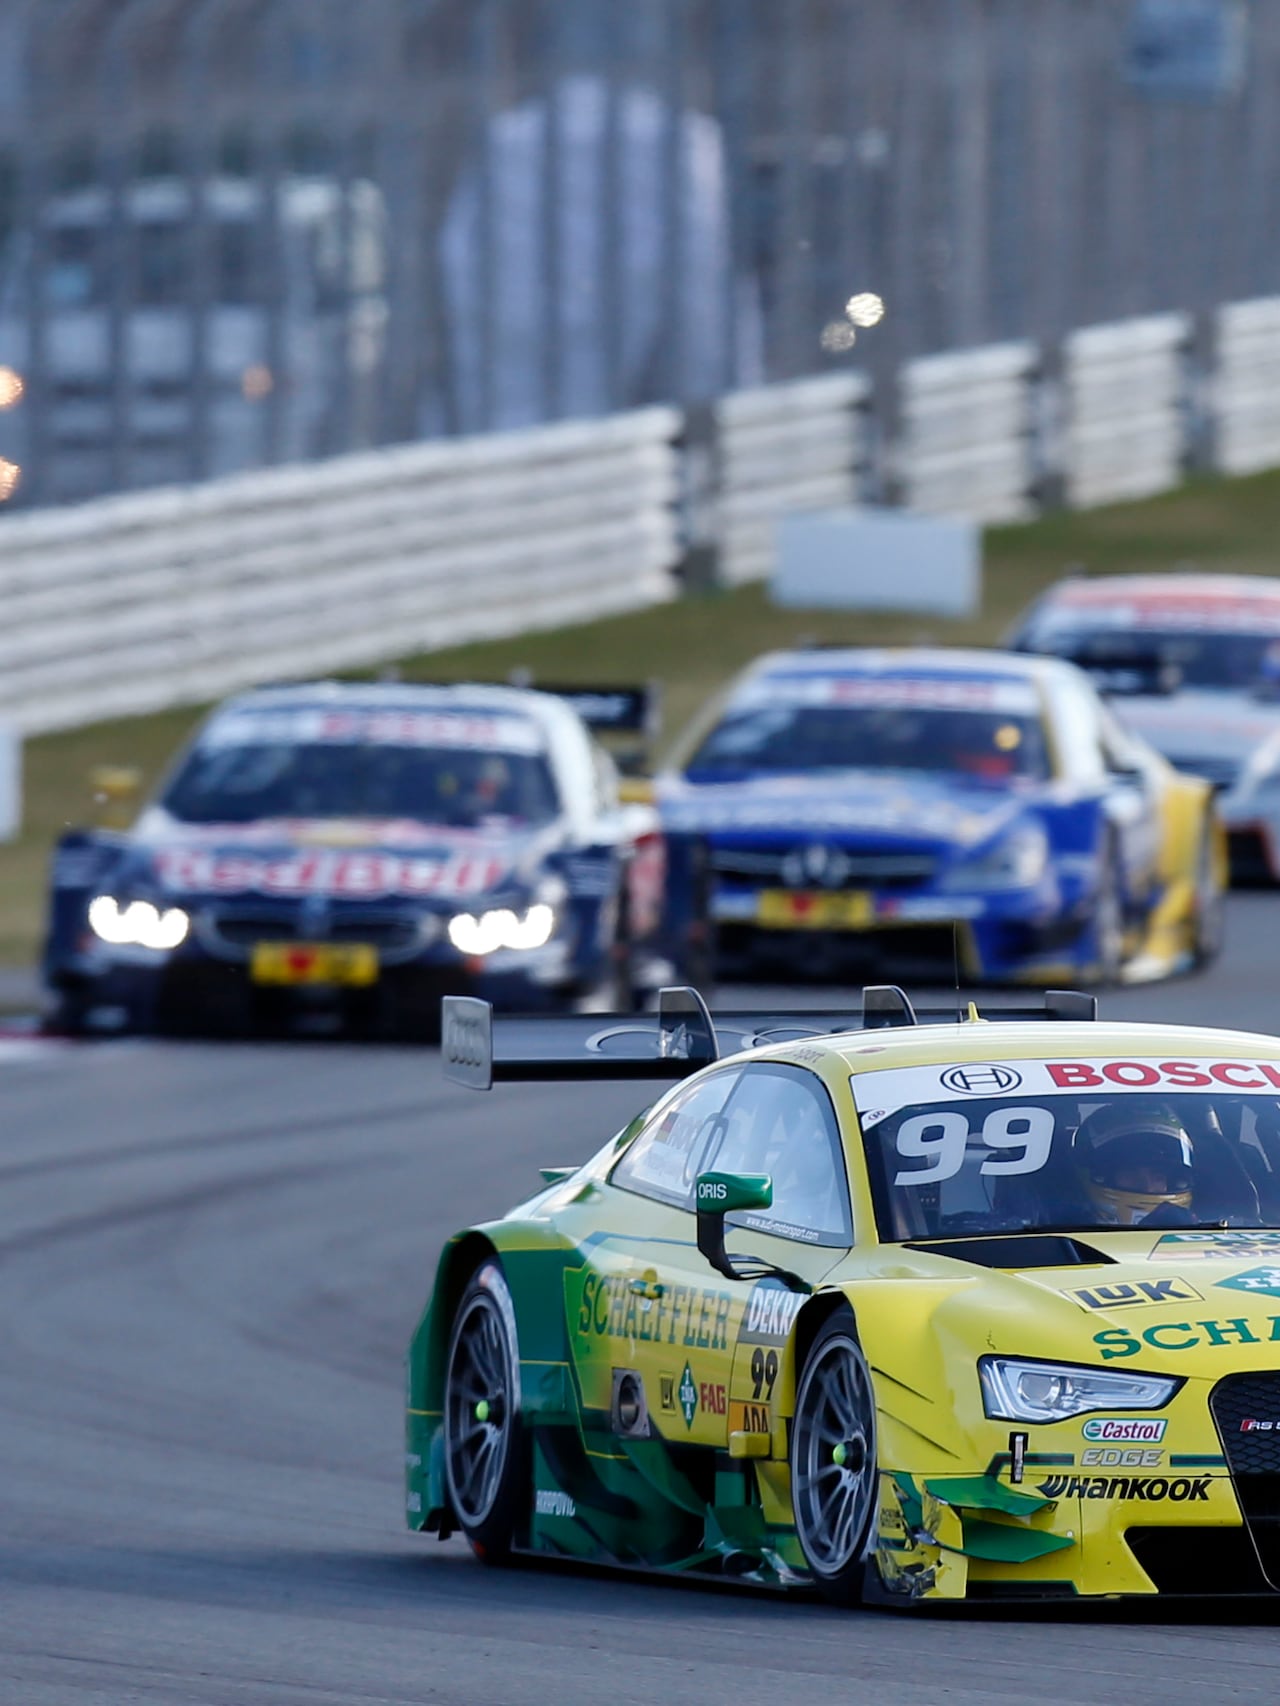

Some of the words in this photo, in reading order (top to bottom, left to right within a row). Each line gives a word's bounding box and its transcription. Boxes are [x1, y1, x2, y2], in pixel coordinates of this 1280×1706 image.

[895, 1106, 1057, 1187] 99
[697, 1182, 728, 1200] ORIS
[751, 1347, 779, 1401] 99
[700, 1382, 726, 1416] FAG
[1101, 1421, 1161, 1440] Castrol
[1080, 1447, 1165, 1468] EDGE
